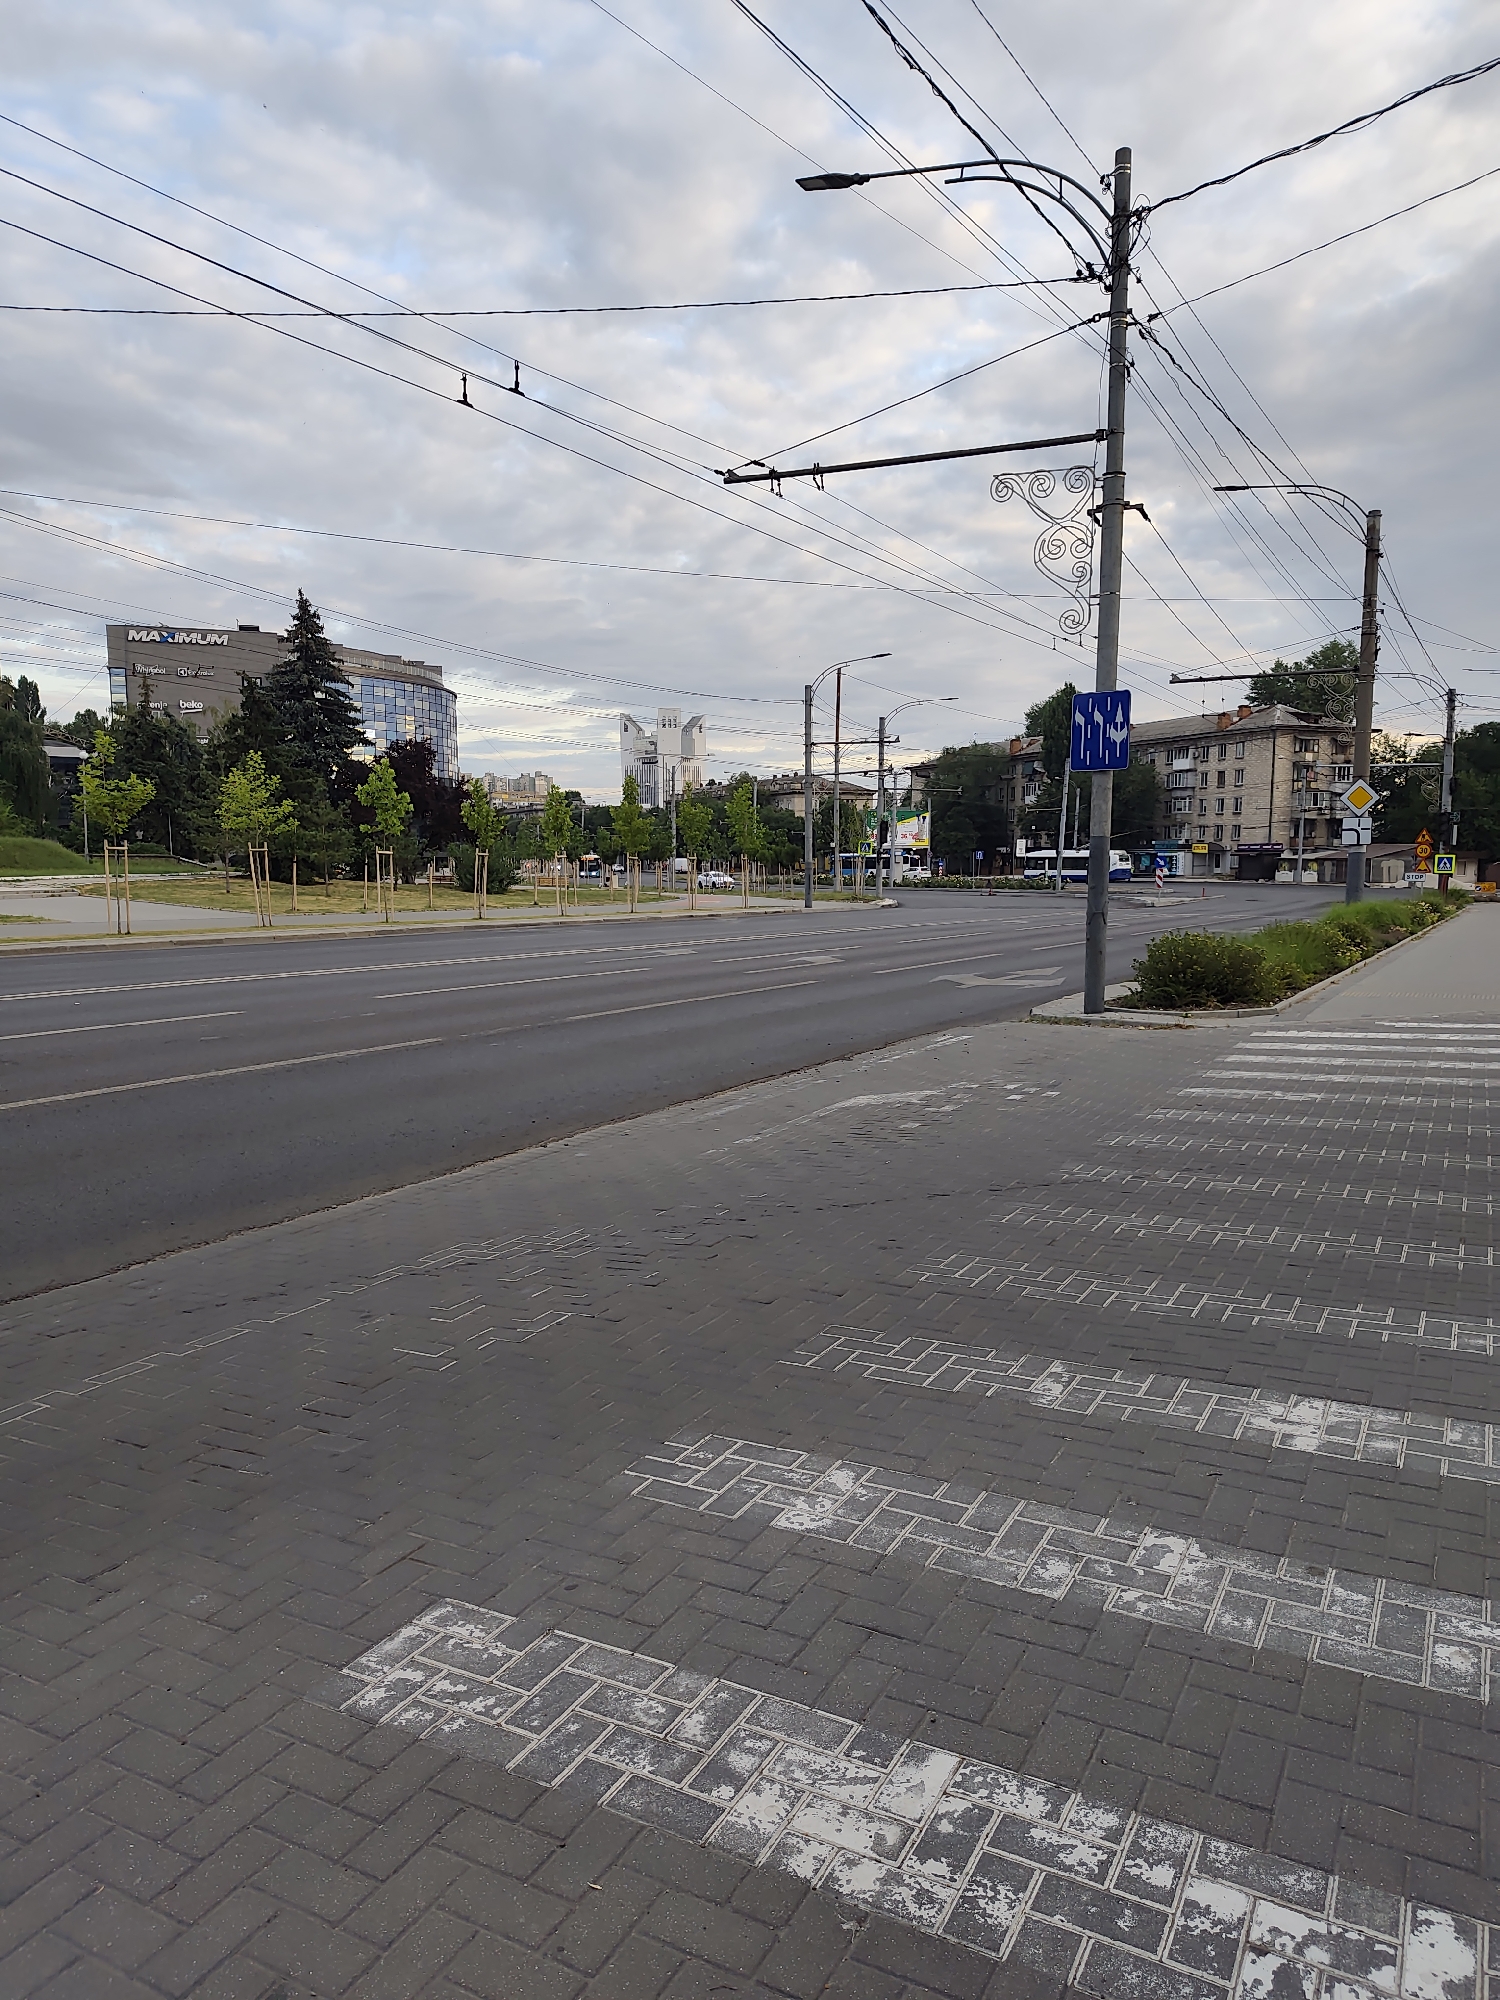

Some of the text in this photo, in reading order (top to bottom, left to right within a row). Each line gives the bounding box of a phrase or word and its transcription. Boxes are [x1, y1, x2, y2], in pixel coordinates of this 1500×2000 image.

[127, 629, 229, 646] MAXIMUM
[179, 699, 204, 709] beko
[1419, 847, 1428, 855] 30
